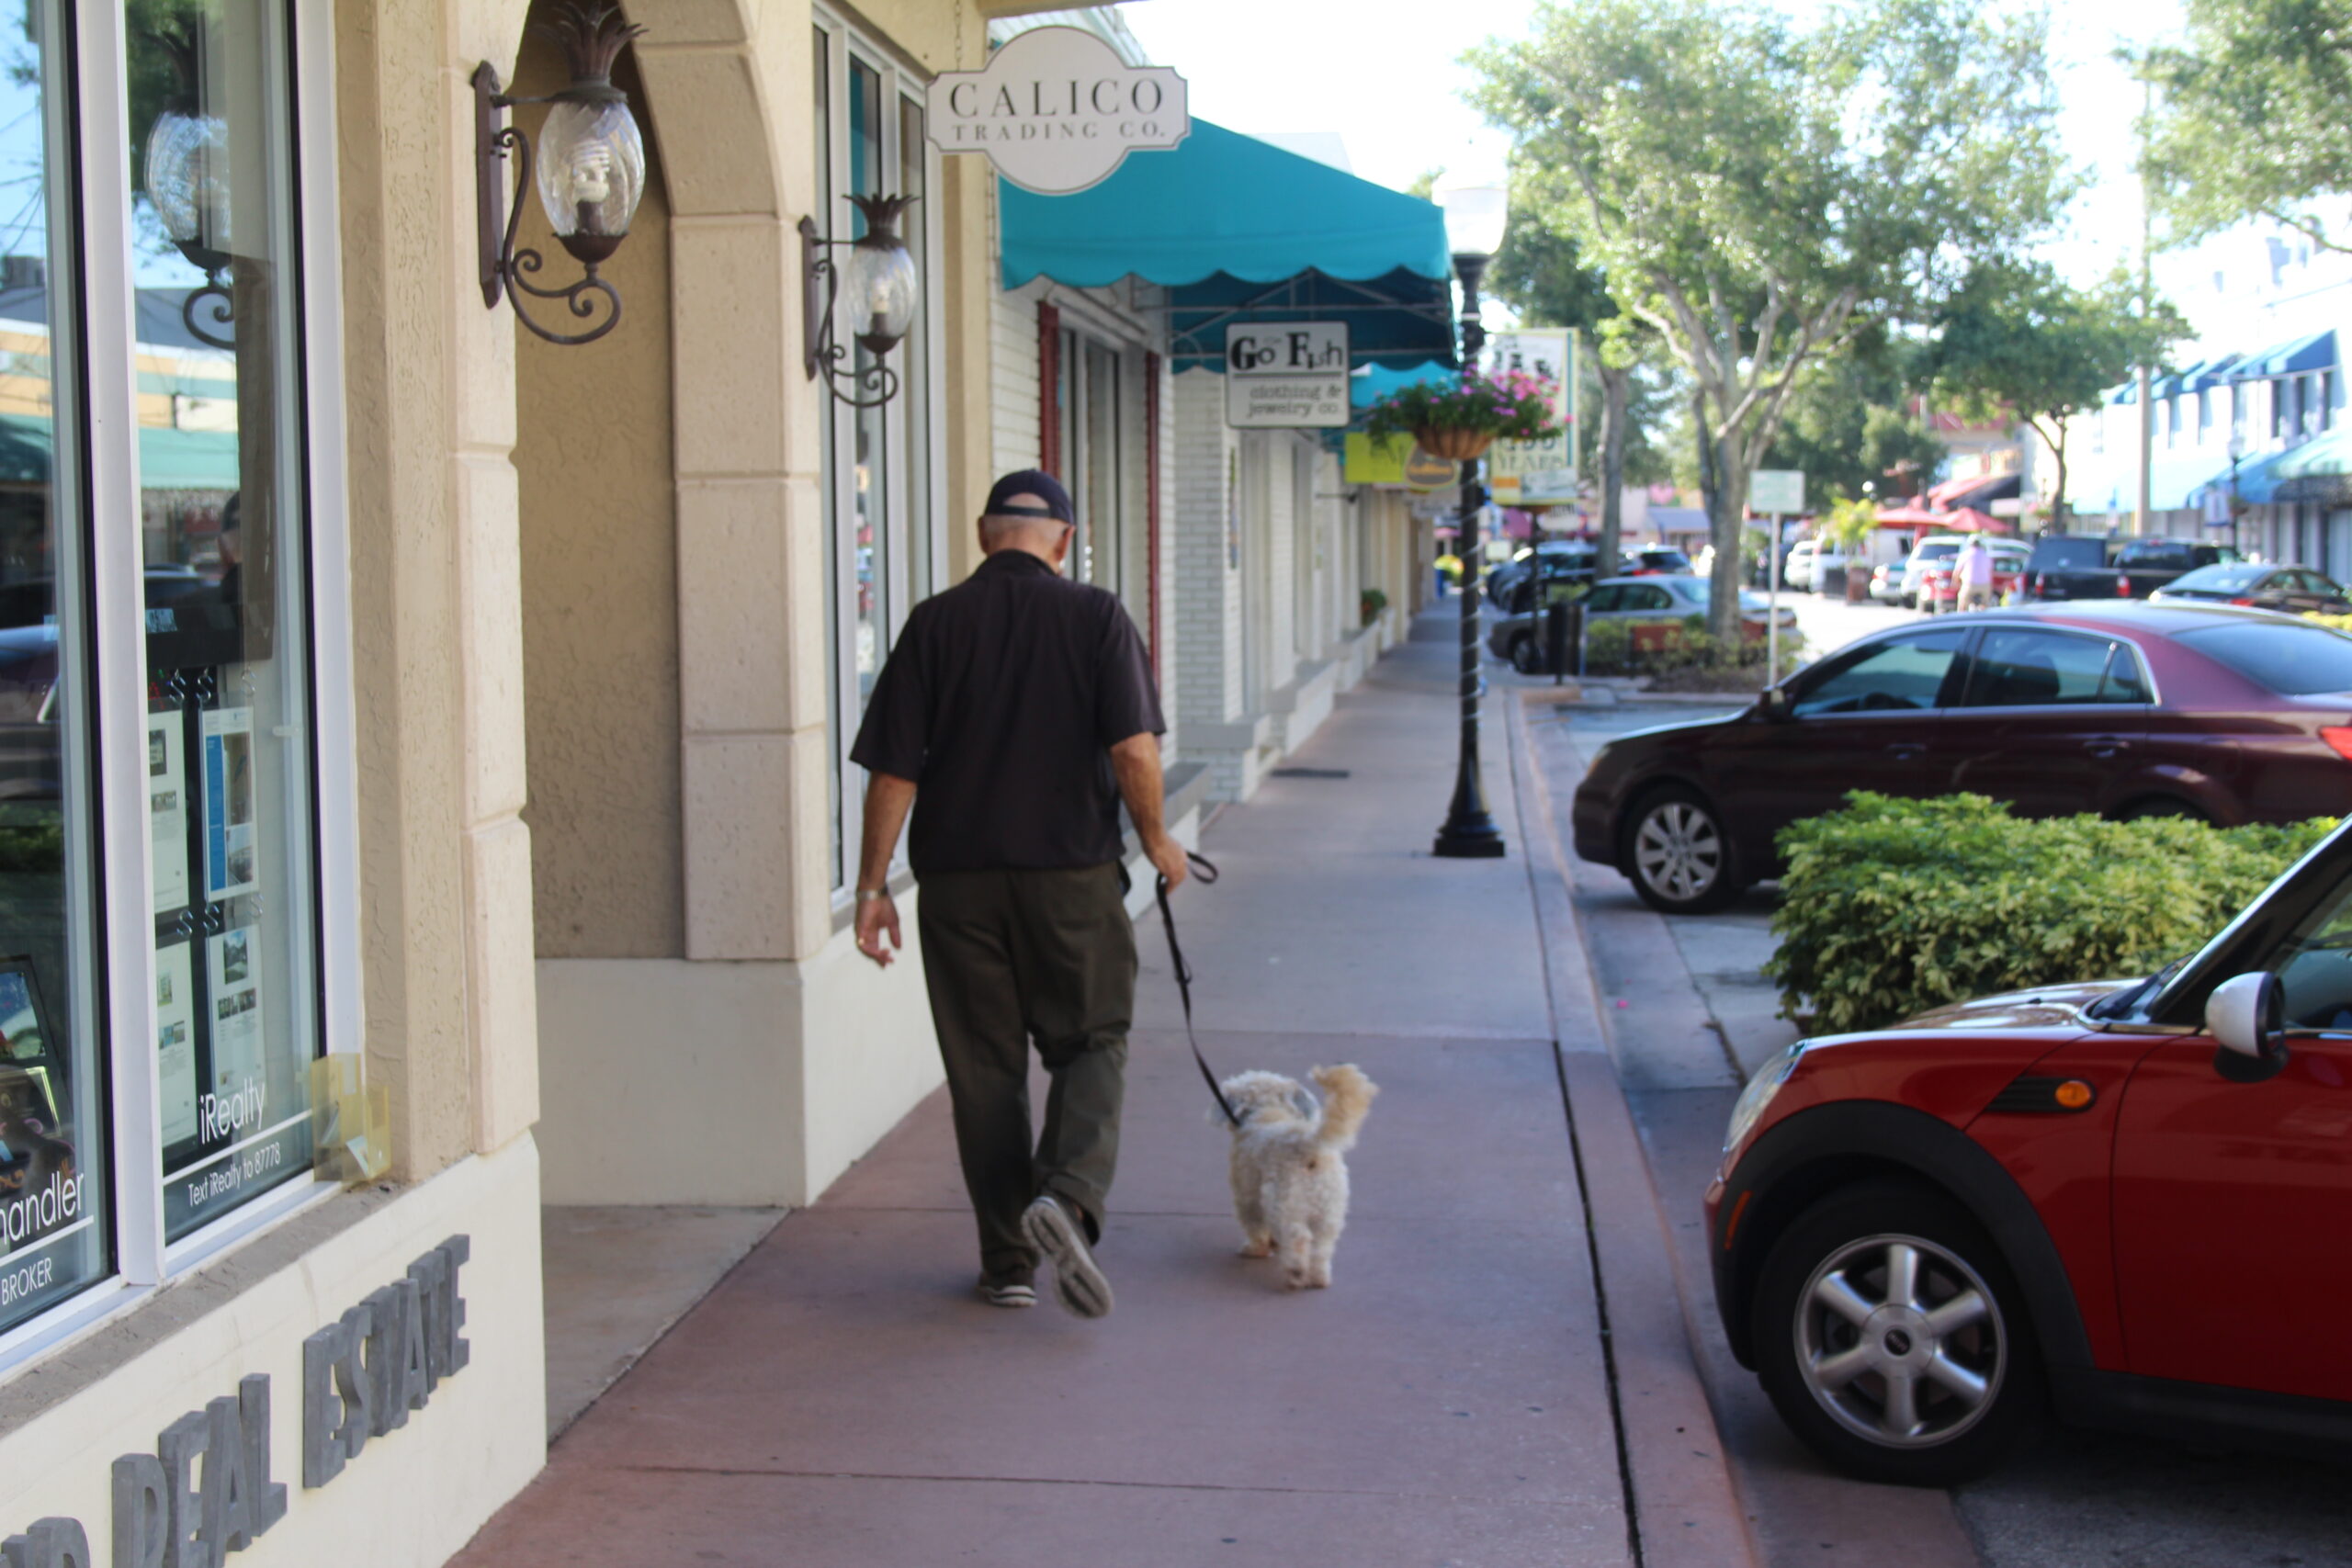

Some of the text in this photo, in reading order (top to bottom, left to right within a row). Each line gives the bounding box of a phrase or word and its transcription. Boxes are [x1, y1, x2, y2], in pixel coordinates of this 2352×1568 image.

[949, 78, 1163, 118] CALICO
[952, 120, 1165, 141] TRADING CO.
[1231, 331, 1342, 370] Go Fish
[1246, 401, 1312, 419] jewelry
[1250, 385, 1321, 401] clothing
[200, 1076, 266, 1145] iRealty
[188, 1142, 281, 1208] Text iRealty to 87778
[2, 1257, 52, 1305] BROKER
[303, 1234, 470, 1489] ESTATE
